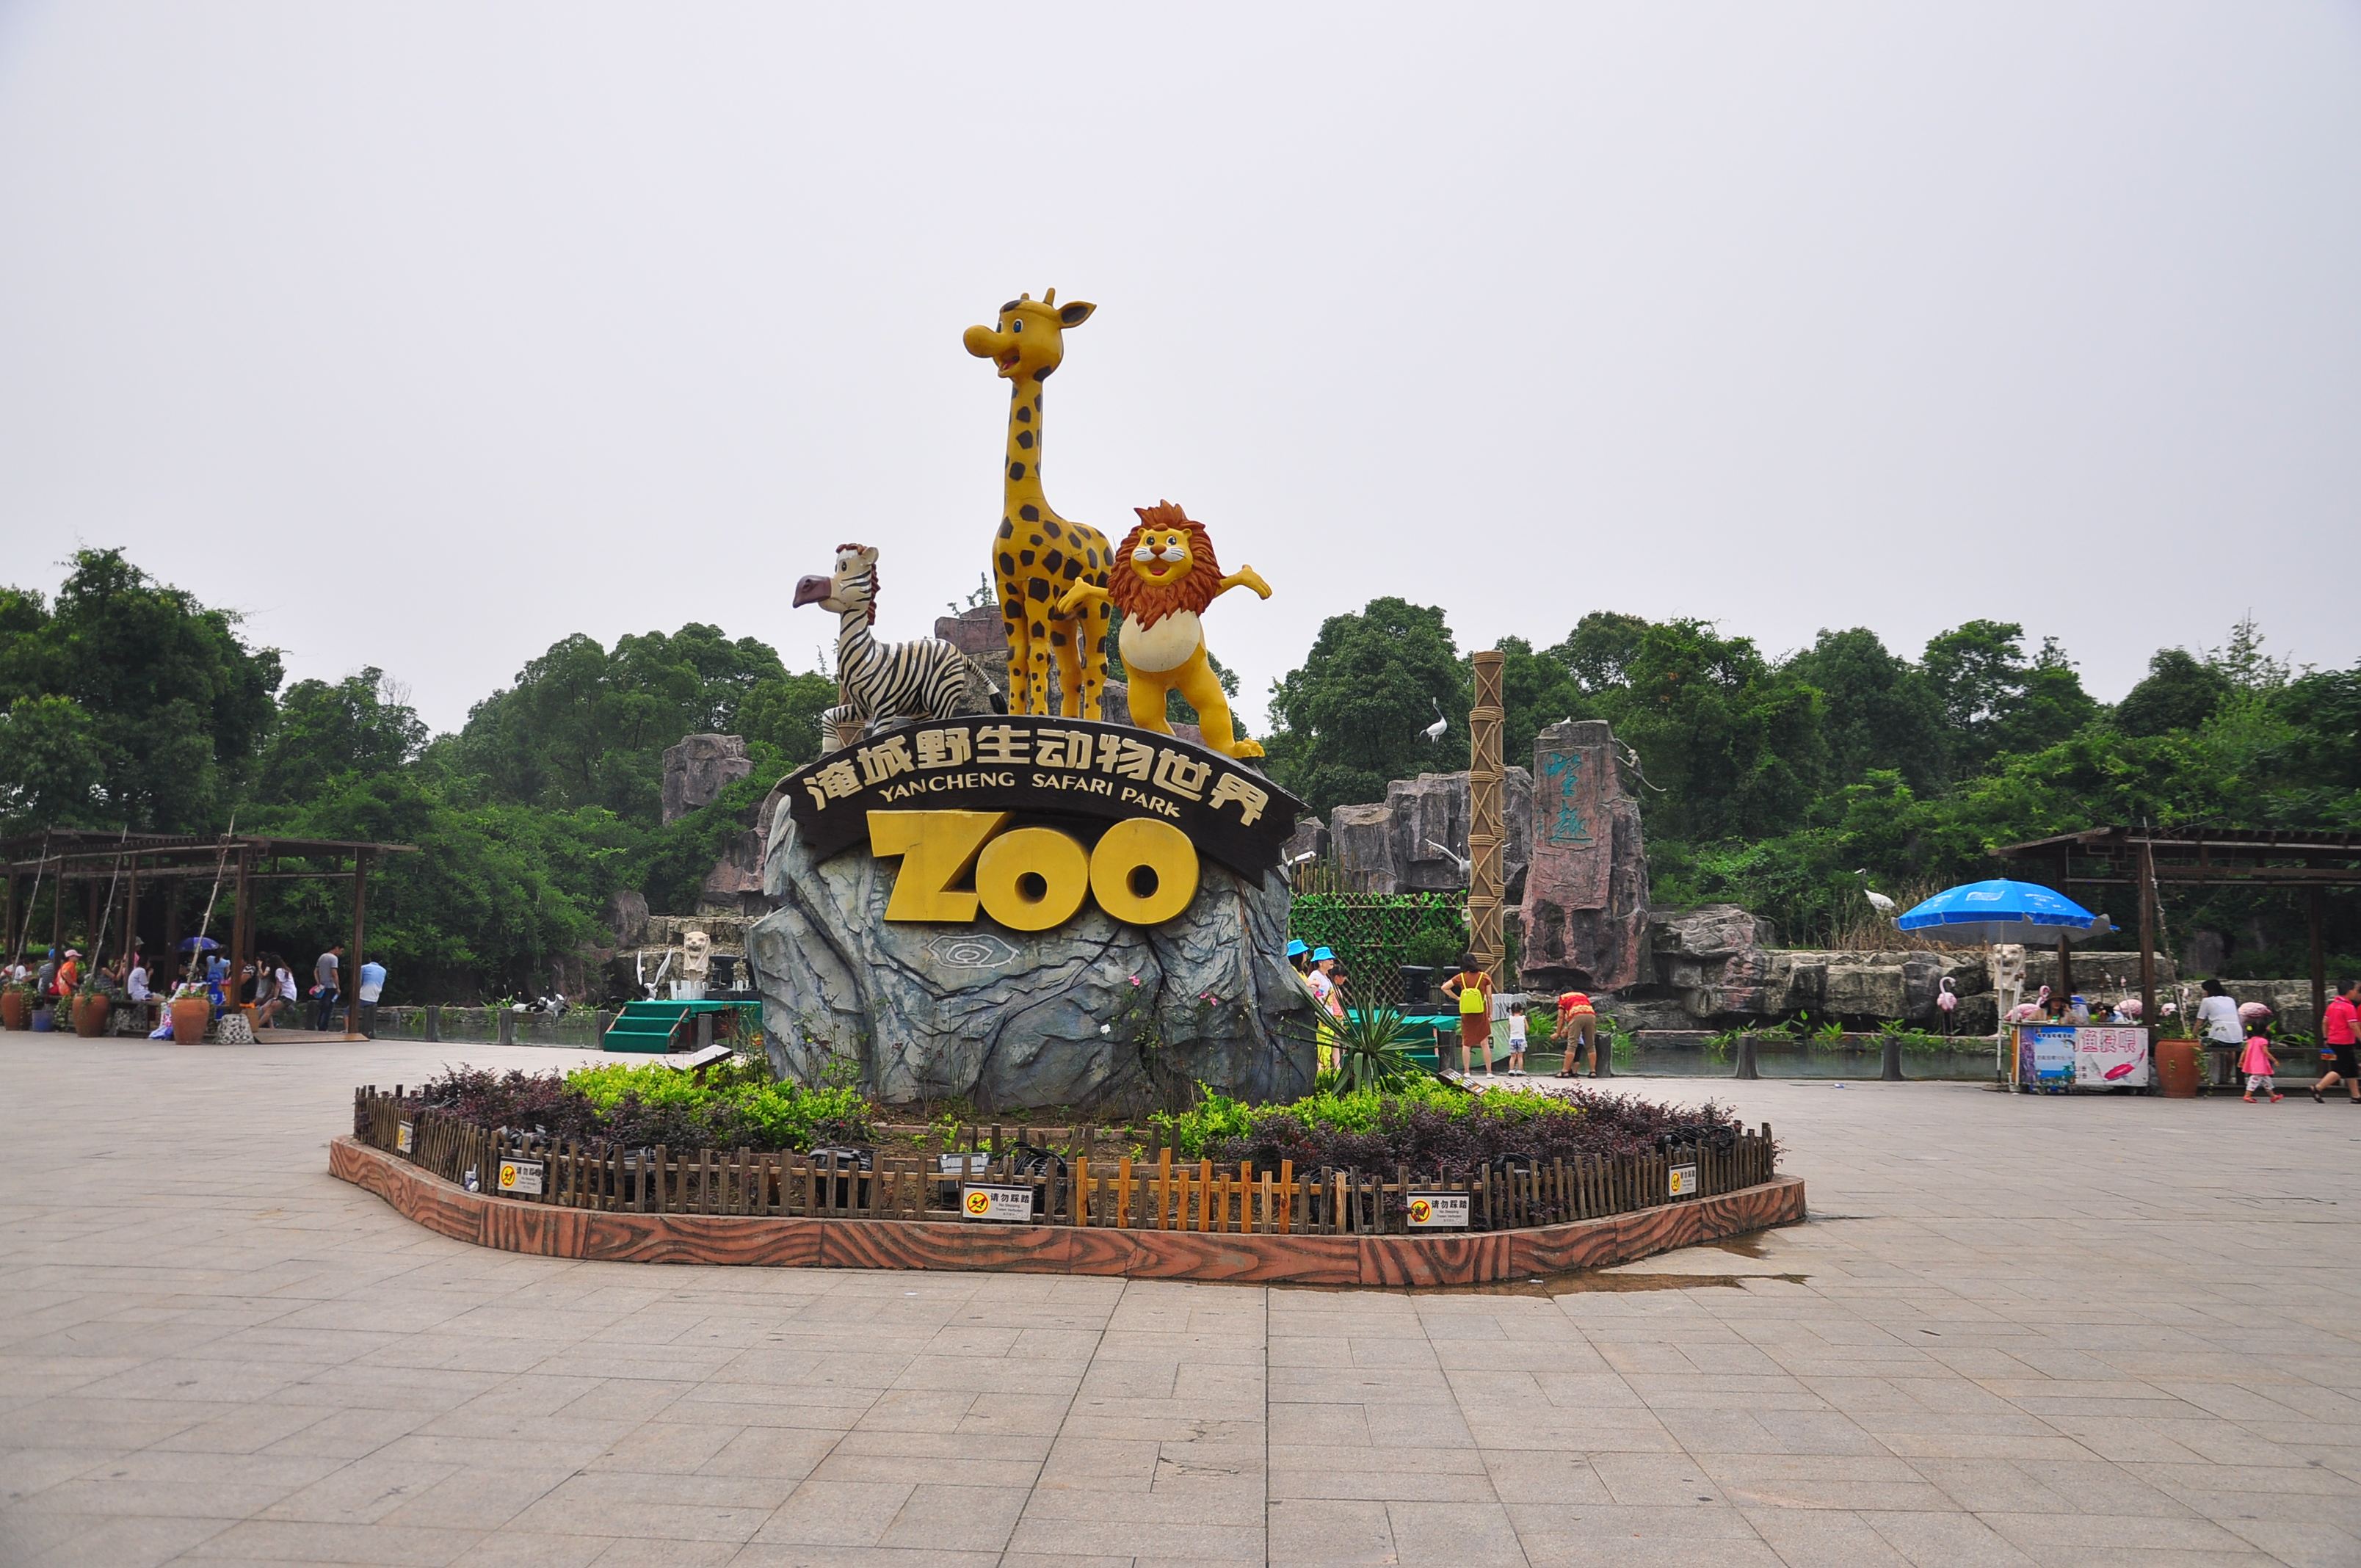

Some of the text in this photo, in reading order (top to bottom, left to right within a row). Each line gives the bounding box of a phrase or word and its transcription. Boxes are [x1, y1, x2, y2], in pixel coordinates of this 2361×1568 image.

[802, 725, 1270, 827] 淹城野生动物世界
[878, 772, 1182, 819] YANCHENG SAFARI PARK
[866, 809, 1200, 932] ZOO
[990, 1193, 1029, 1203] 请勿踩踏
[1432, 1199, 1467, 1208] 请勿踩踏
